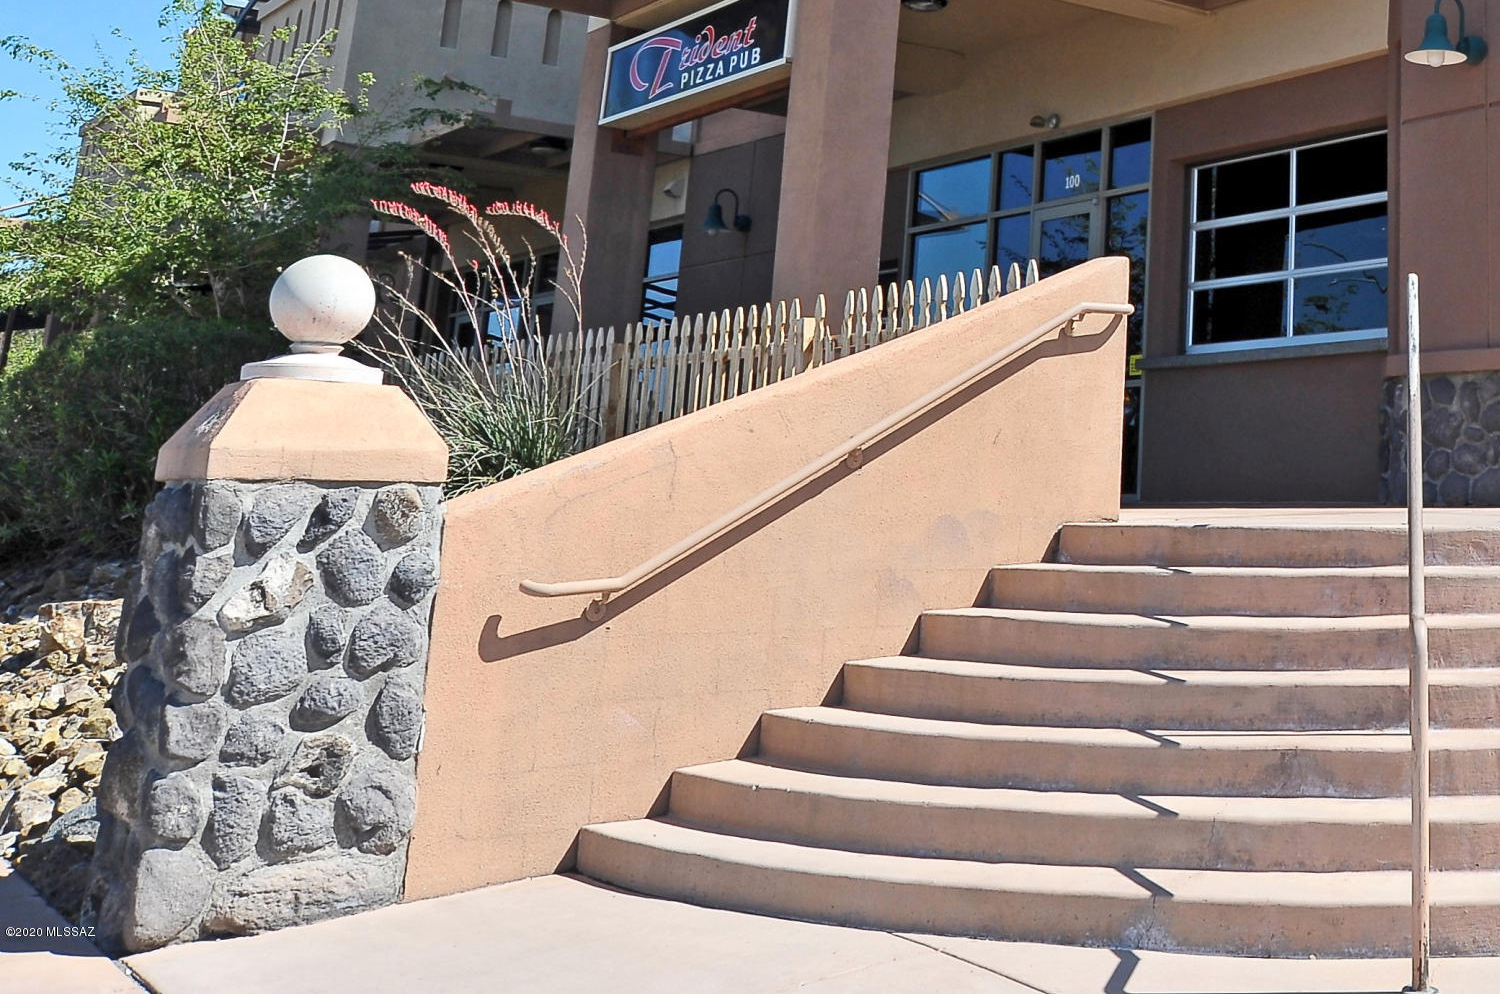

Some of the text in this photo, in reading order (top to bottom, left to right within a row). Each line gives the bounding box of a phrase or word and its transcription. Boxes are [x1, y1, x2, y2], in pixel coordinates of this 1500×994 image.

[629, 16, 757, 99] Trident
[680, 47, 761, 89] PIZZA PUB
[1065, 174, 1081, 189] 100
